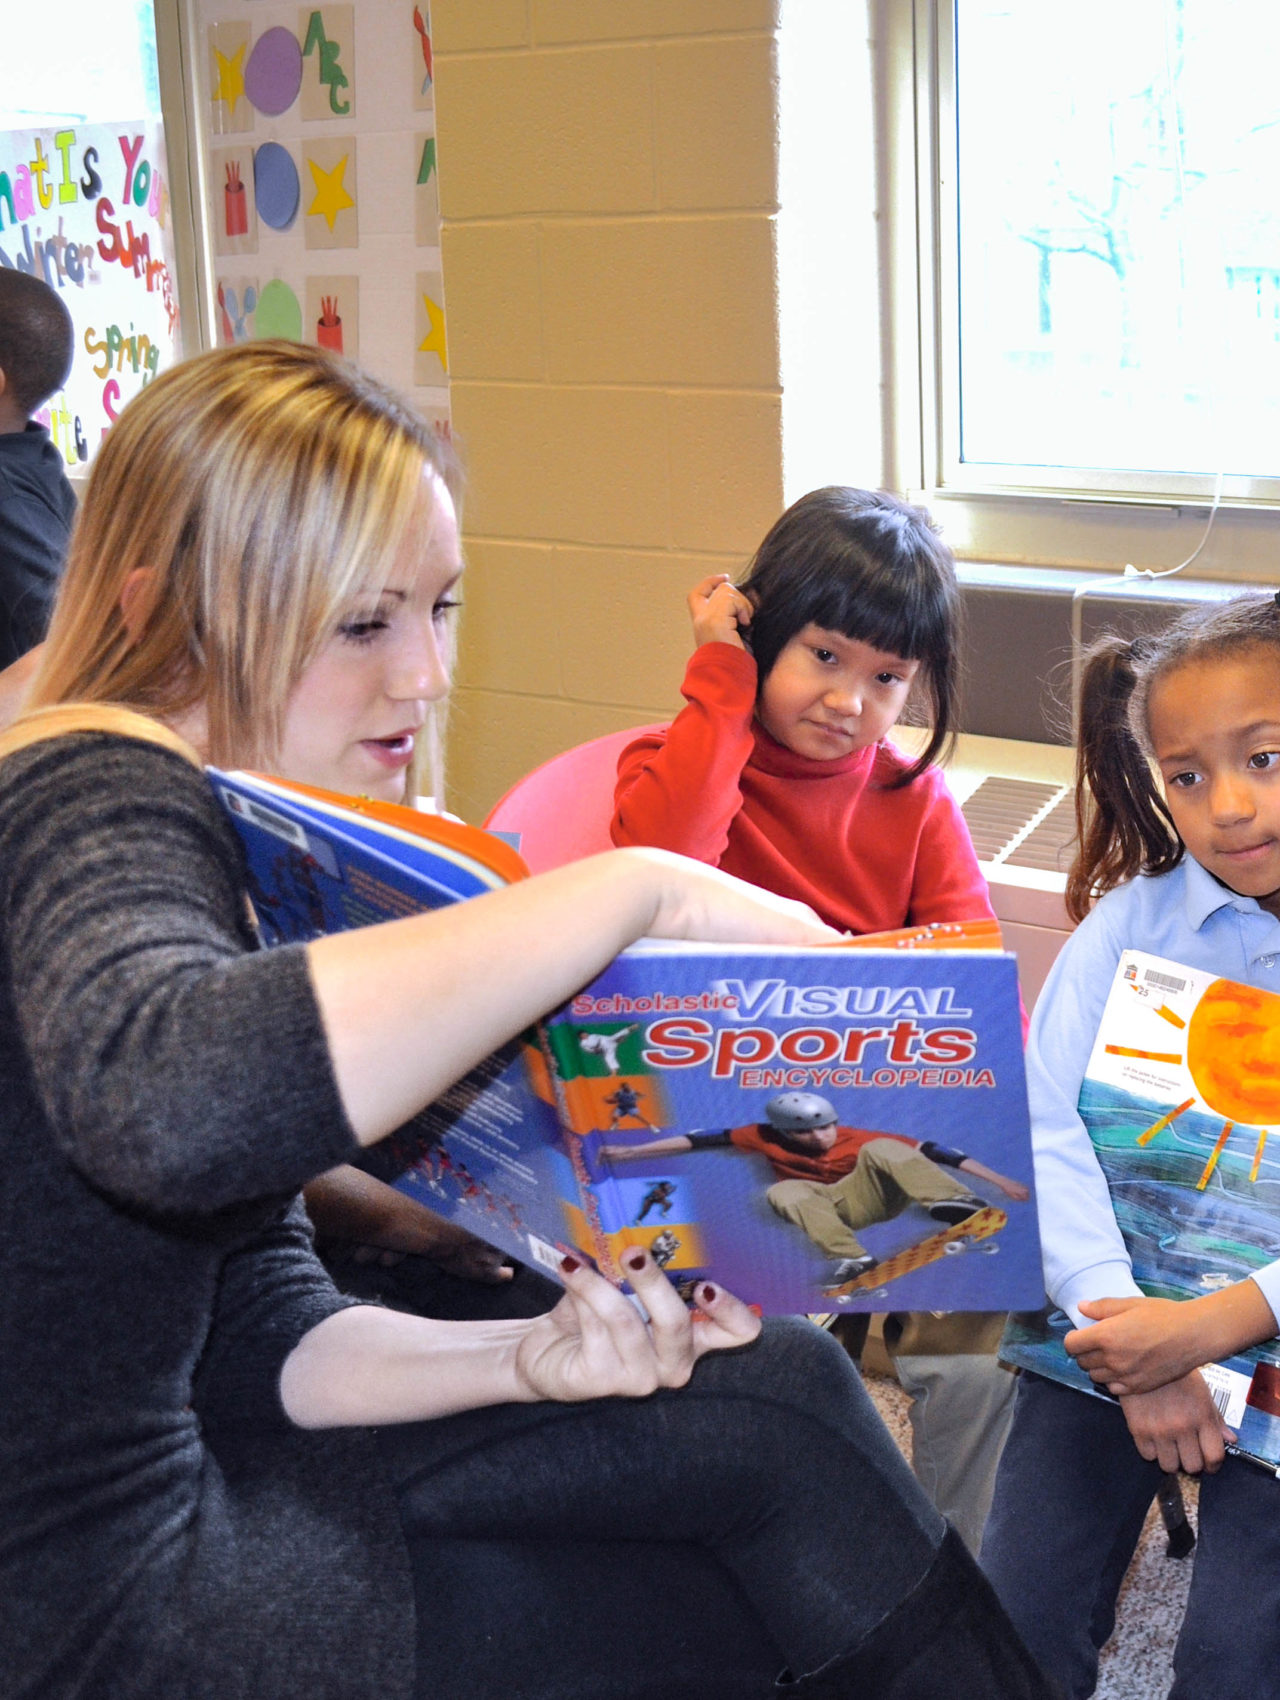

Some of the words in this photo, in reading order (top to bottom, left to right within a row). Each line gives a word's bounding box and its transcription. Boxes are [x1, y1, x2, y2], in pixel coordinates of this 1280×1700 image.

[303, 11, 350, 115] ABC
[572, 992, 739, 1017] Scholastic
[643, 1017, 978, 1078] Sports
[740, 1067, 996, 1089] ENCYCLOPEDIA
